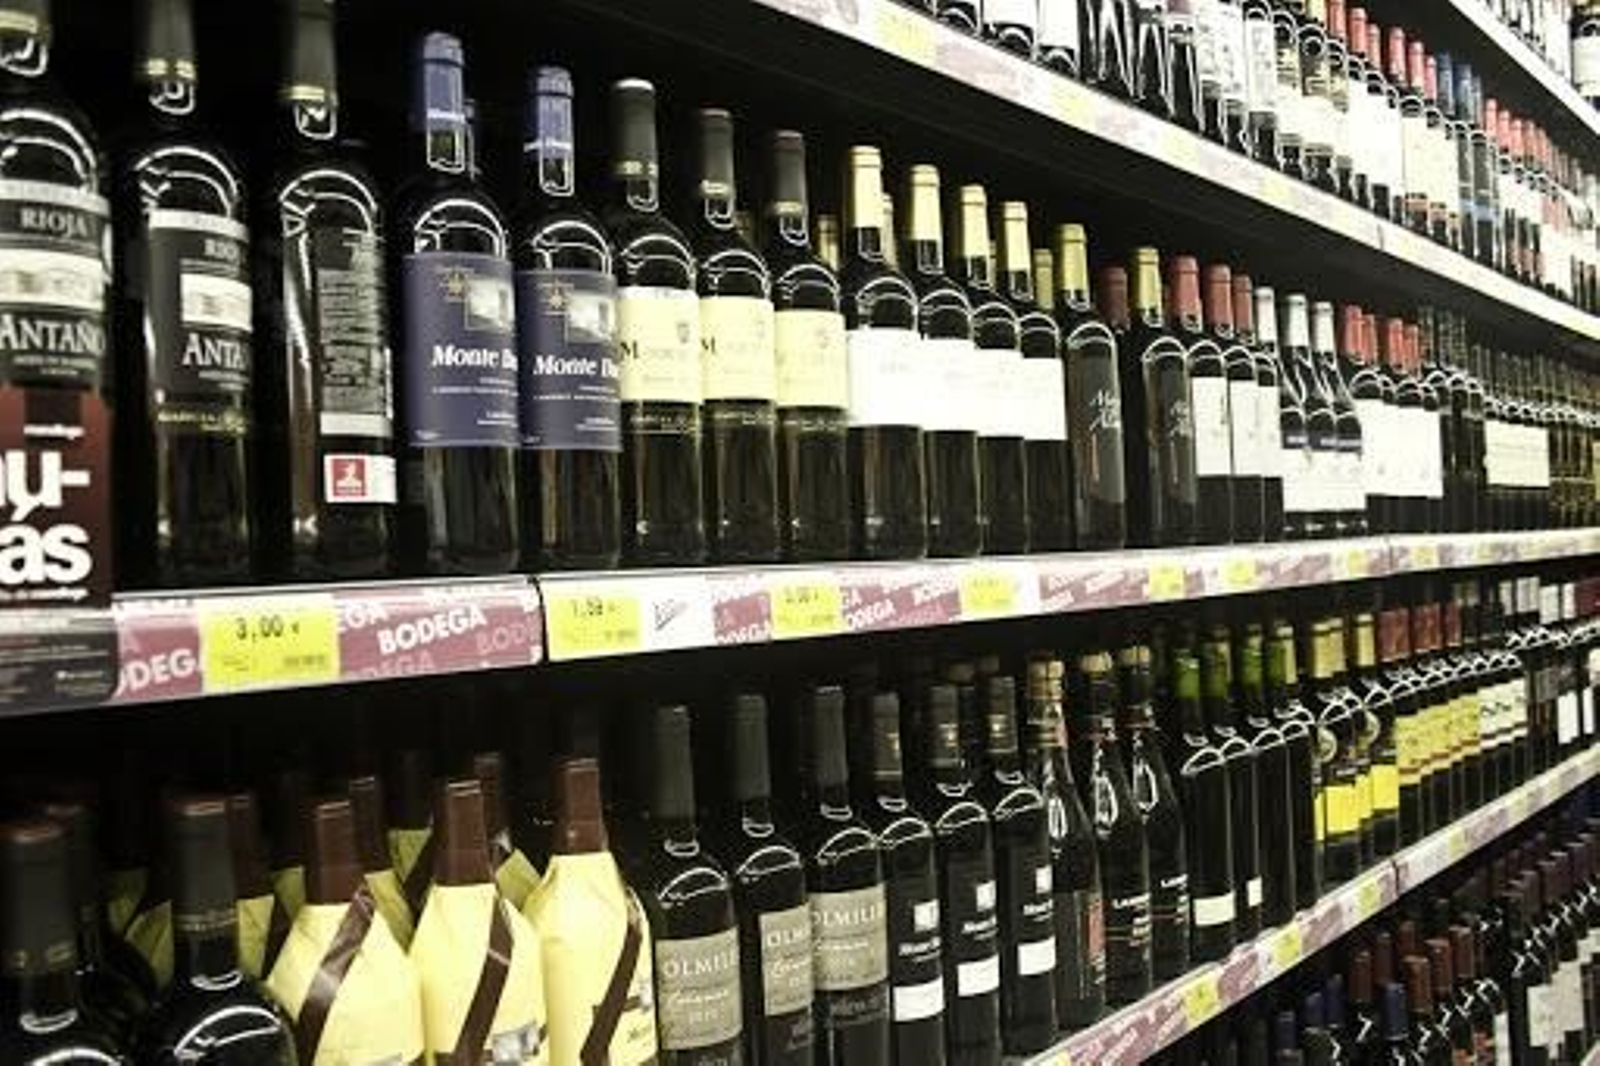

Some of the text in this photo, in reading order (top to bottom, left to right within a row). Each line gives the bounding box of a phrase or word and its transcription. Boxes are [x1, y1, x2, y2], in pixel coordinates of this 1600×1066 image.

[20, 206, 88, 238] RIOJA
[432, 345, 500, 368] Monte
[533, 355, 597, 375] Monte
[235, 614, 284, 641] 3,00
[376, 604, 487, 655] BODEGA
[116, 647, 203, 698] DEG
